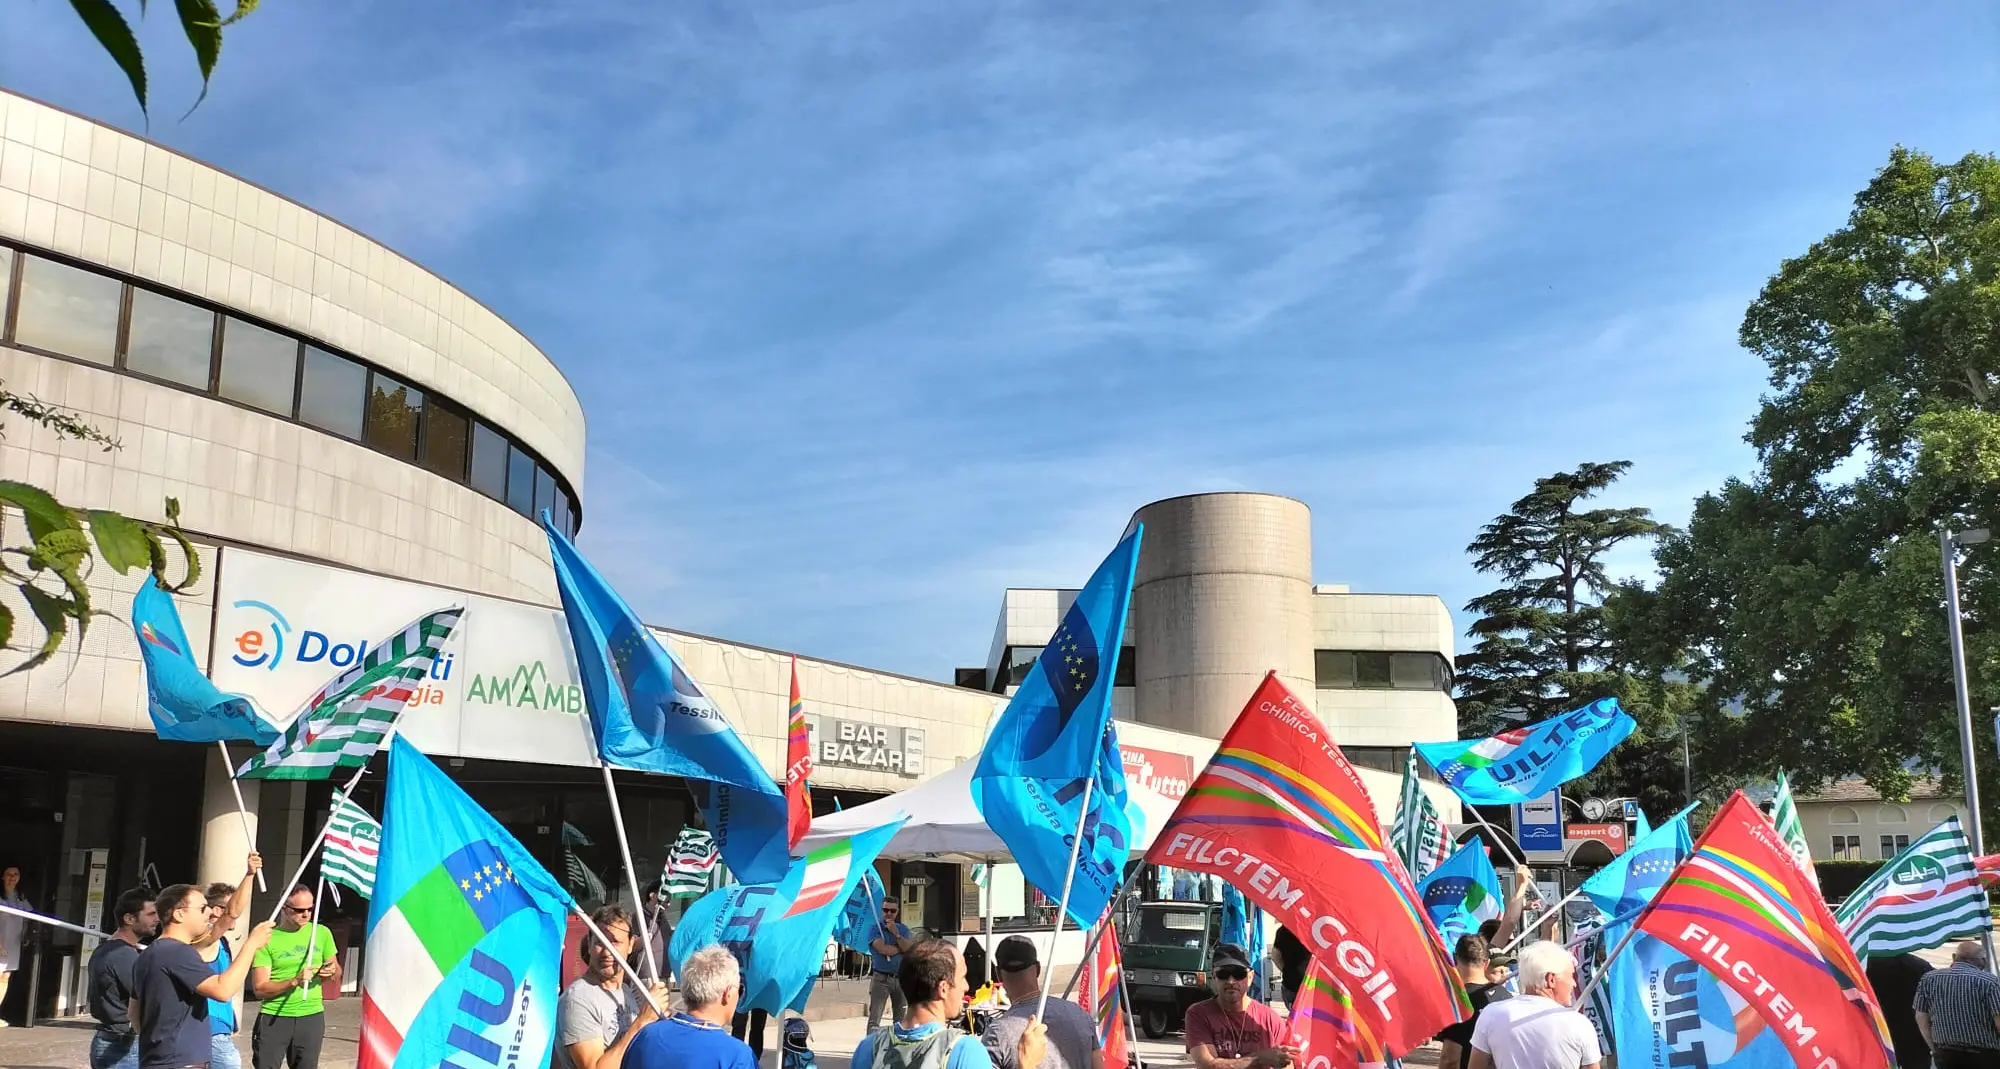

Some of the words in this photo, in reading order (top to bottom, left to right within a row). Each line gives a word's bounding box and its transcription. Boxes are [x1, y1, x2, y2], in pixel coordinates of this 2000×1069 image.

[296, 630, 454, 681] Dolti
[467, 661, 588, 714] AMAMB
[840, 722, 888, 745] BAR
[1260, 701, 1317, 743] CHIMICA
[1486, 700, 1618, 782] UILTEC
[823, 741, 903, 768] BAZAR
[1022, 777, 1062, 830] nergia
[1569, 827, 1607, 836] expert
[903, 877, 926, 885] ENTRATA
[1166, 832, 1398, 1022] FILCTEM-CGIL
[1650, 968, 1660, 1017] Tessile
[1652, 1021, 1664, 1069] Energi
